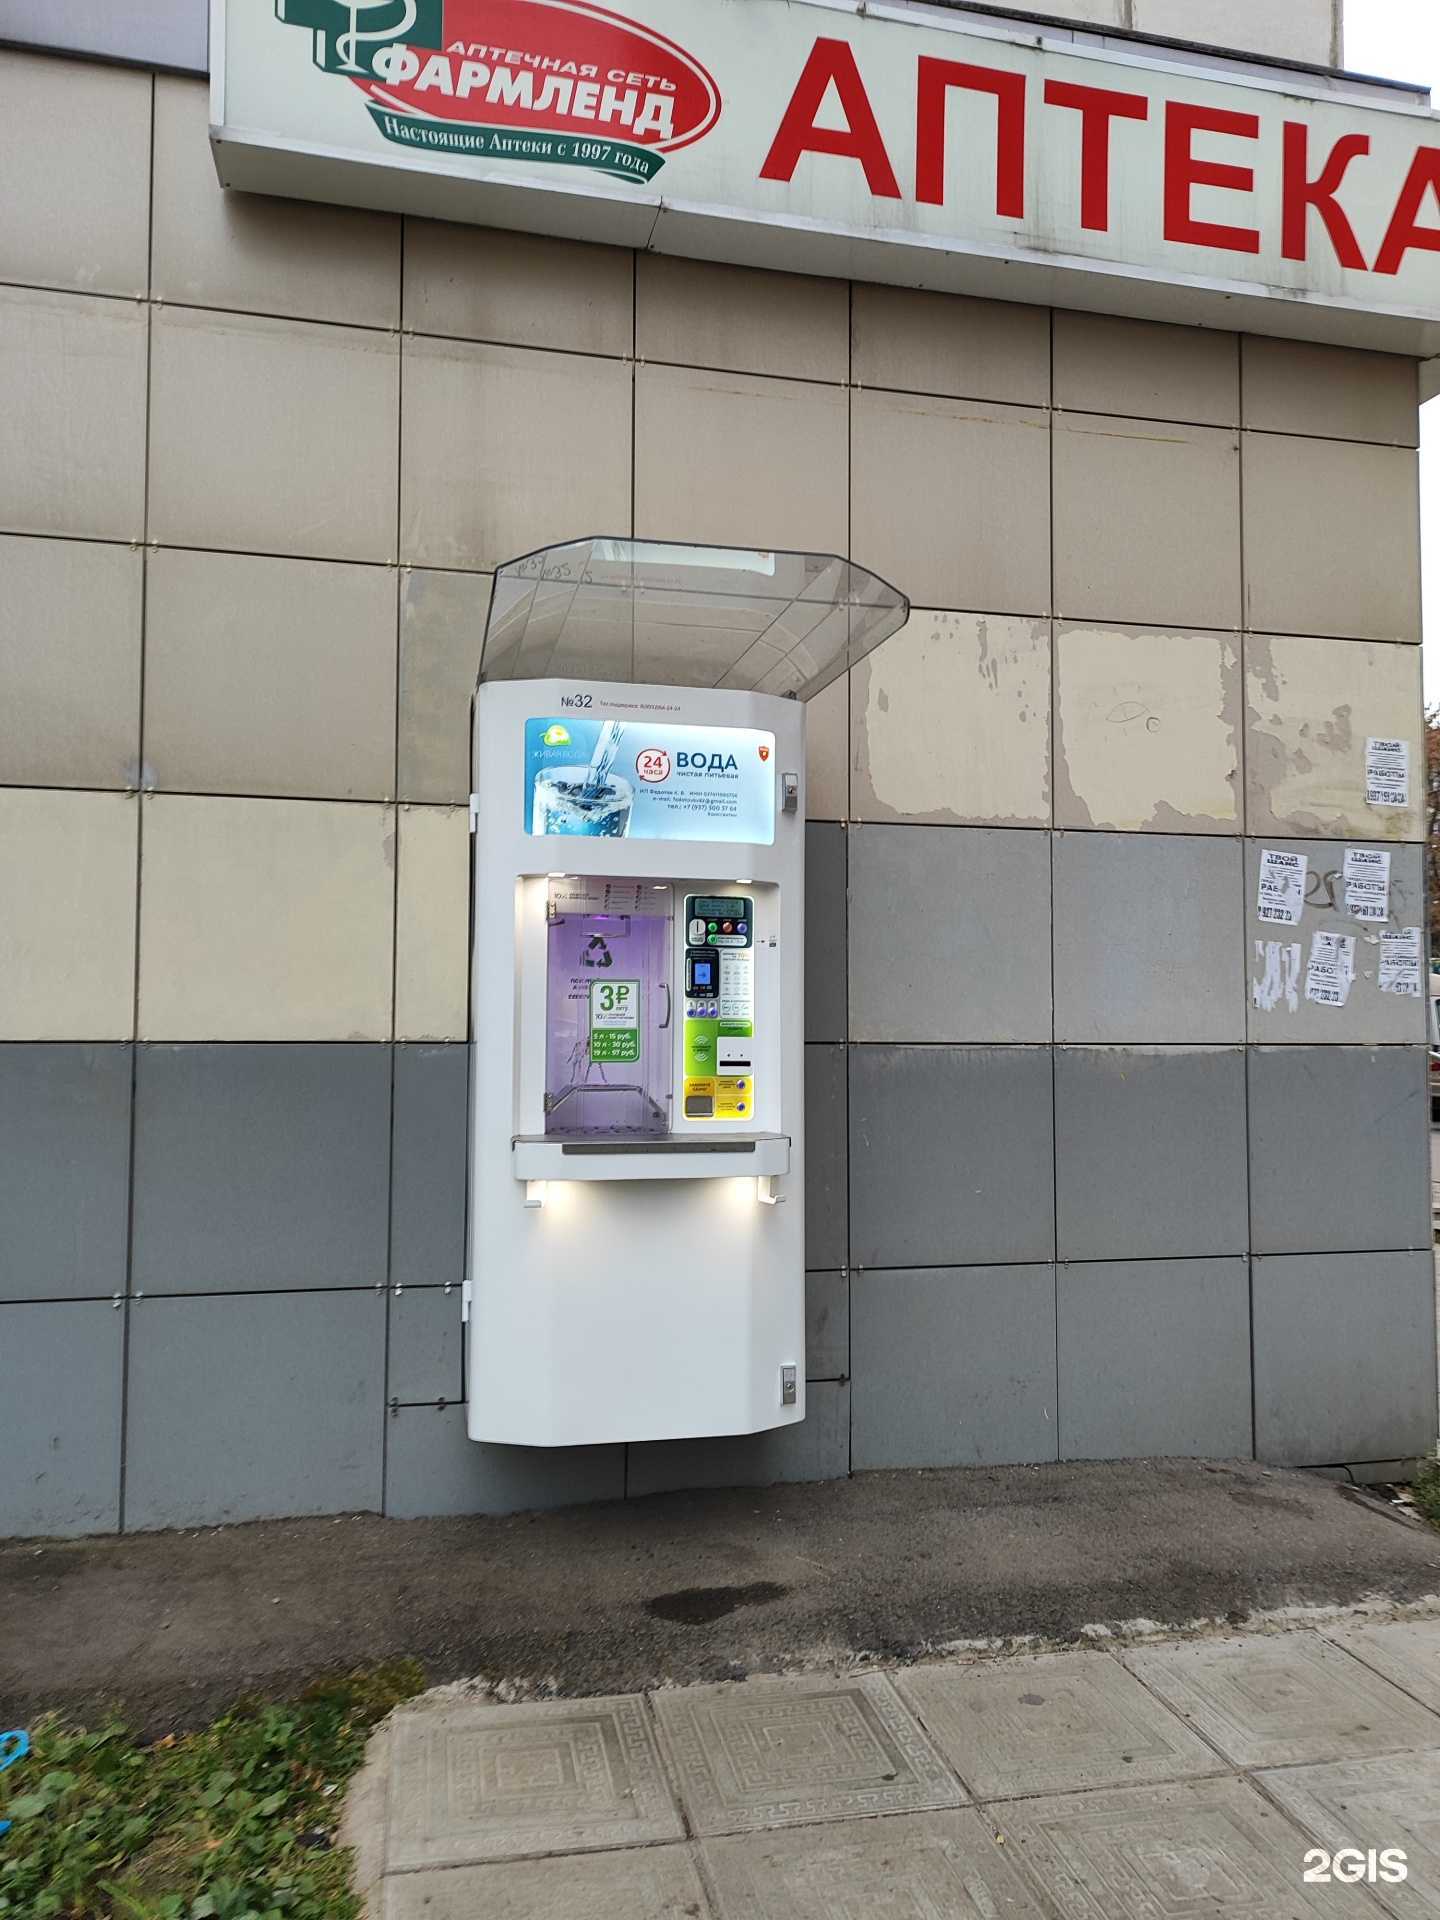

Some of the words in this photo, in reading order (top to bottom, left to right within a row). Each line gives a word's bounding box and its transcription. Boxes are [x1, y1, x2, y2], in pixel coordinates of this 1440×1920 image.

[446, 40, 599, 78] АПТЕЧНАЯ
[606, 69, 677, 92] СЕТЬ
[371, 42, 675, 140] ФАРМЛЕНД
[384, 115, 485, 149] Настоящие
[488, 133, 552, 155] Аптеки
[557, 144, 566, 156] с
[572, 142, 612, 161] 1997
[613, 151, 649, 174] года
[758, 36, 1440, 275] АПТЕКА
[560, 694, 593, 709] №32
[643, 755, 663, 769] 24
[676, 751, 738, 772] ВОДА
[1266, 859, 1300, 868] ШАНС
[1268, 853, 1299, 863] ТВОЙ
[1344, 881, 1386, 892] РАБОТЫ
